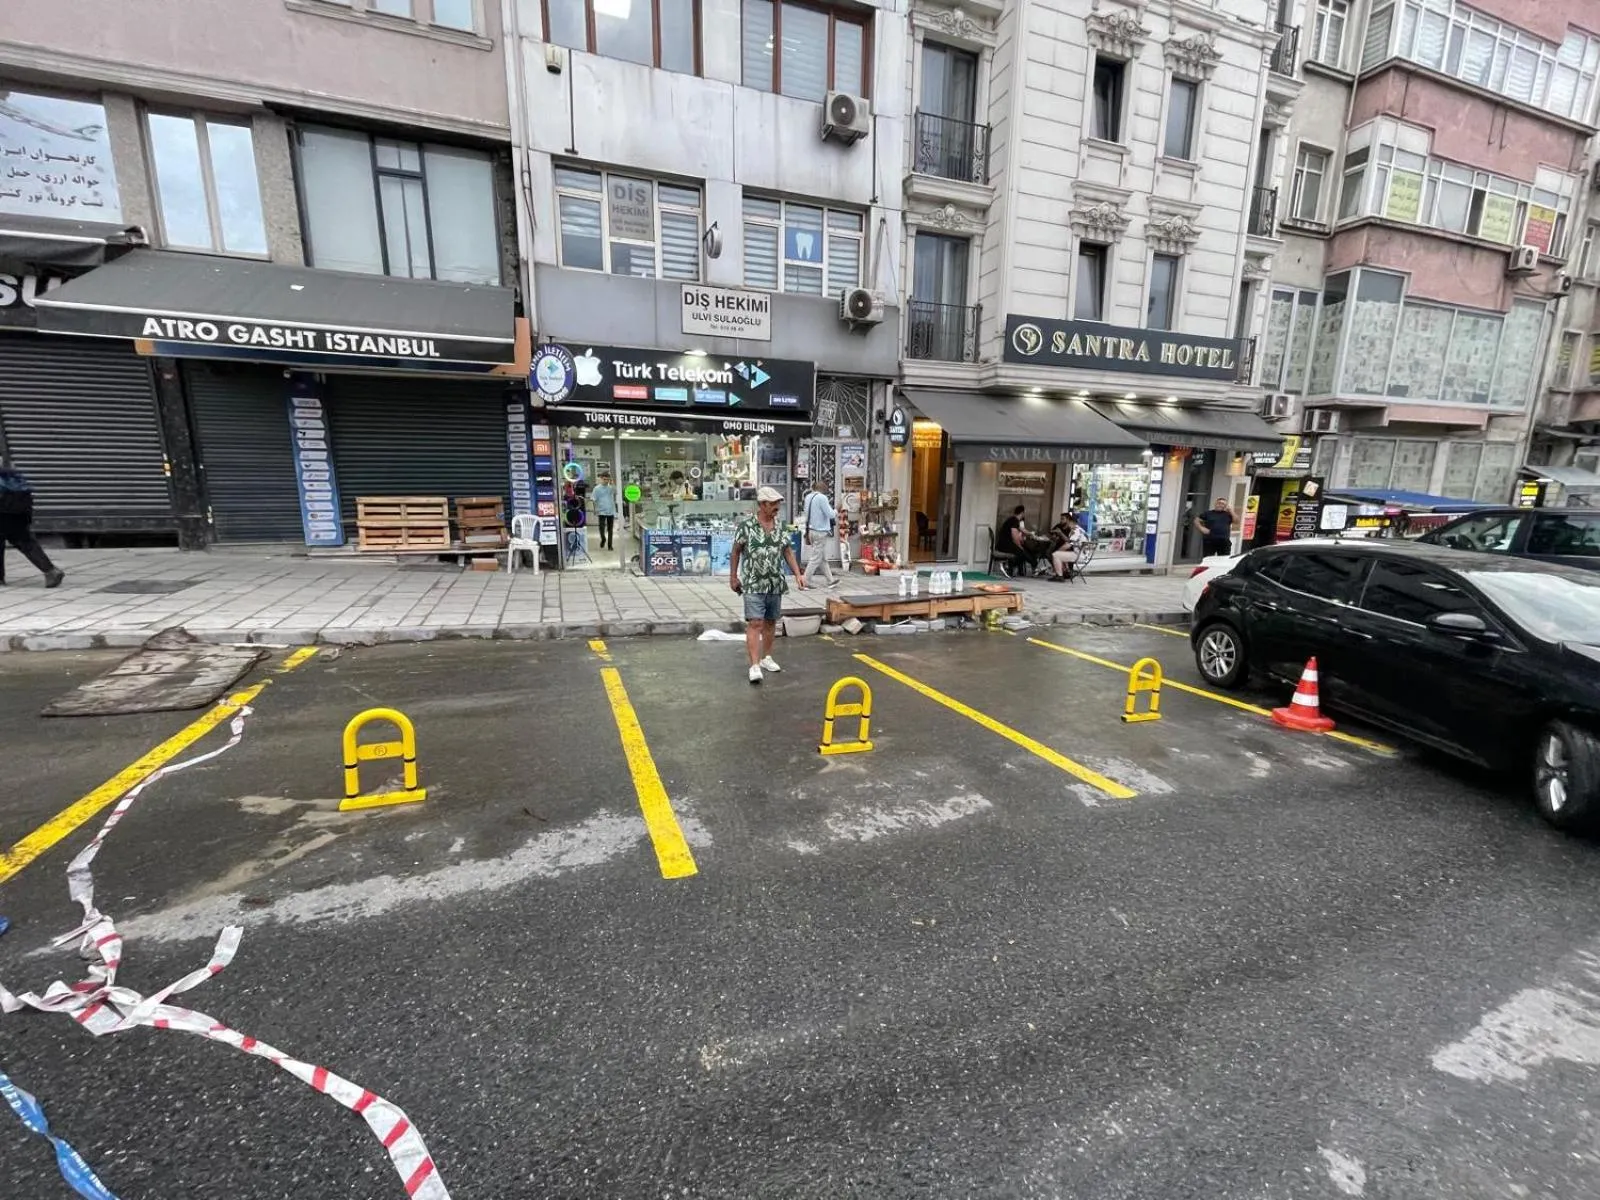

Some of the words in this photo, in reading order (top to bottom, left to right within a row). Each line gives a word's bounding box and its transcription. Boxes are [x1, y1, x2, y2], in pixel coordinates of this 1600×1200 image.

[615, 183, 646, 205] DİŞ
[612, 204, 649, 217] HEKİMİ
[684, 291, 710, 311] DİŞ
[715, 294, 768, 313] HEKİMİ
[142, 317, 218, 340] ATRO
[228, 324, 317, 349] GASHT
[1051, 331, 1149, 362] SANTRA
[1160, 342, 1234, 369] HOTEL
[613, 360, 652, 380] Türk
[656, 363, 733, 384] Telekom
[584, 412, 612, 424] TÜRK
[613, 414, 656, 426] TELEKOM
[723, 421, 742, 430] OMO
[744, 421, 774, 433] BİLİŞİM
[990, 446, 1051, 461] SANTRA
[1060, 448, 1111, 462] HOTEL
[651, 557, 664, 566] 50
[664, 557, 677, 566] GB
